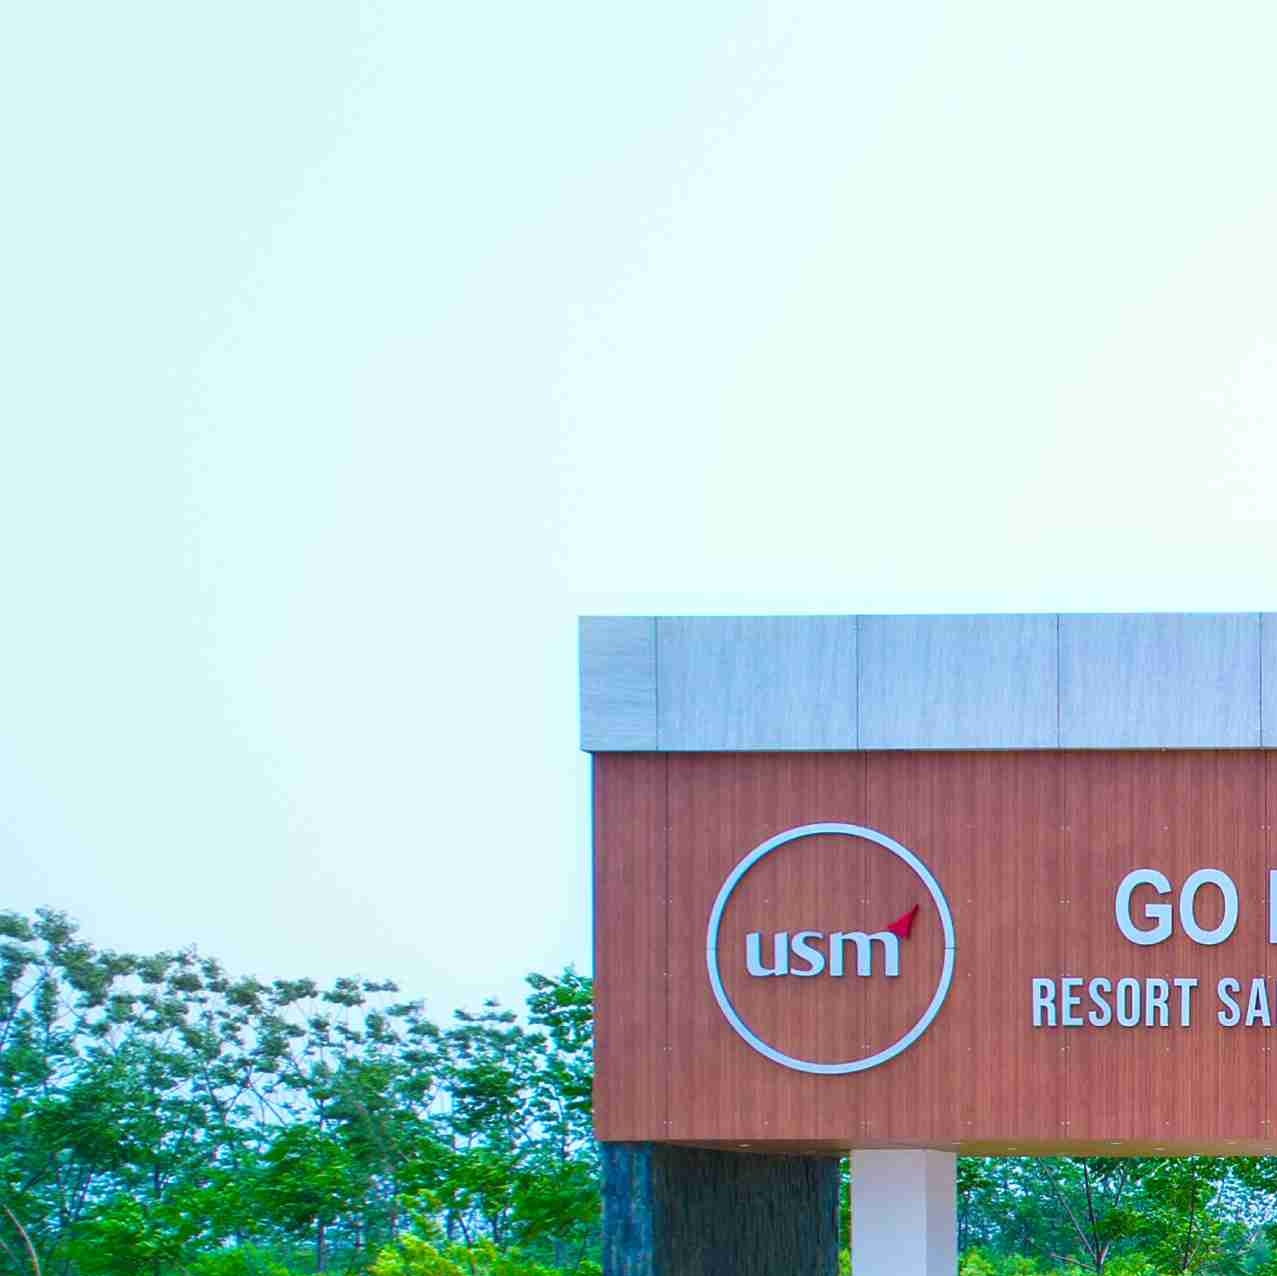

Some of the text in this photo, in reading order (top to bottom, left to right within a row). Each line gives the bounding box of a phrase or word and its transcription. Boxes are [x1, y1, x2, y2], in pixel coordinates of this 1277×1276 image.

[1115, 868, 1239, 946] GO
[745, 931, 901, 977] usm
[1032, 976, 1198, 1027] RESORT
